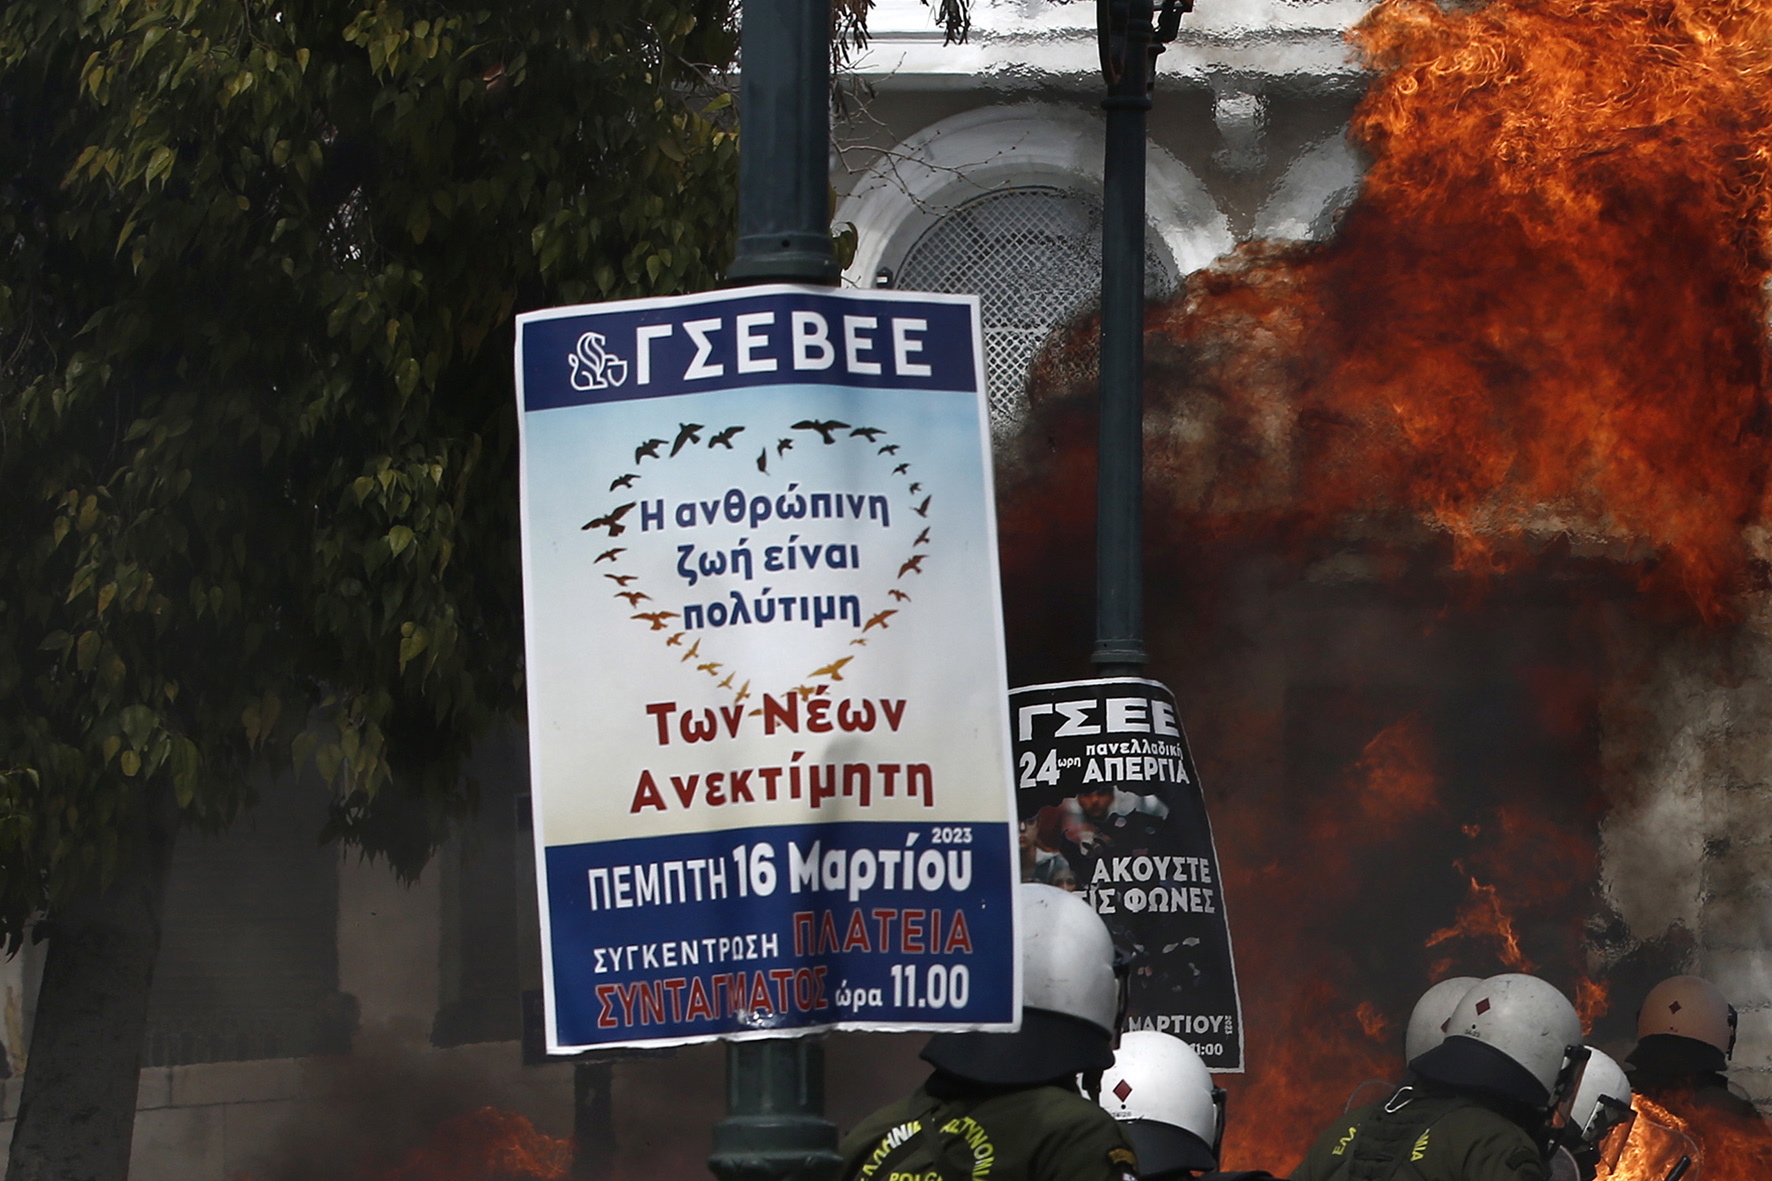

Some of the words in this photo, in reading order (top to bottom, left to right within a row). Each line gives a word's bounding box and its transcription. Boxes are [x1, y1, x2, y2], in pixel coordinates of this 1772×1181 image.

[636, 311, 932, 385] ΓΣΕΒΕΕ
[641, 500, 664, 531] Η
[675, 483, 890, 528] ανθρώπινη
[677, 537, 753, 585] ζωή
[764, 534, 859, 573] είναι
[684, 588, 862, 630] πολύτιμη
[646, 701, 744, 746] Των
[763, 685, 907, 736] Νέων
[1018, 697, 1180, 742] ΓΣΕΕ
[1082, 756, 1190, 784] ΑΠΕΡΓΙΑ
[1086, 738, 1183, 760] πανελλαδική
[630, 752, 934, 814] Ανεκτίμητη
[931, 827, 973, 844] 2023
[587, 858, 727, 911] ΠΕΜΠΤΗ
[733, 843, 777, 898] 16
[788, 833, 972, 902] Μαρτίου
[1090, 856, 1212, 885] ΑΚΟΥΣΤΕ
[1124, 886, 1215, 914] ΦΩΝΕΣ
[593, 933, 779, 974] ΣΥΓΚΕΝΤΡΩΣΗ
[793, 908, 973, 957] ΠΛΑΤΕΙΑ
[596, 966, 829, 1029] ΣΥΝΤΑΓΜΑΤΟΣ
[835, 979, 884, 1013] ώρα
[890, 964, 970, 1009] 11.00
[1128, 1015, 1223, 1034] ΜΑΡΤΙΟΥ
